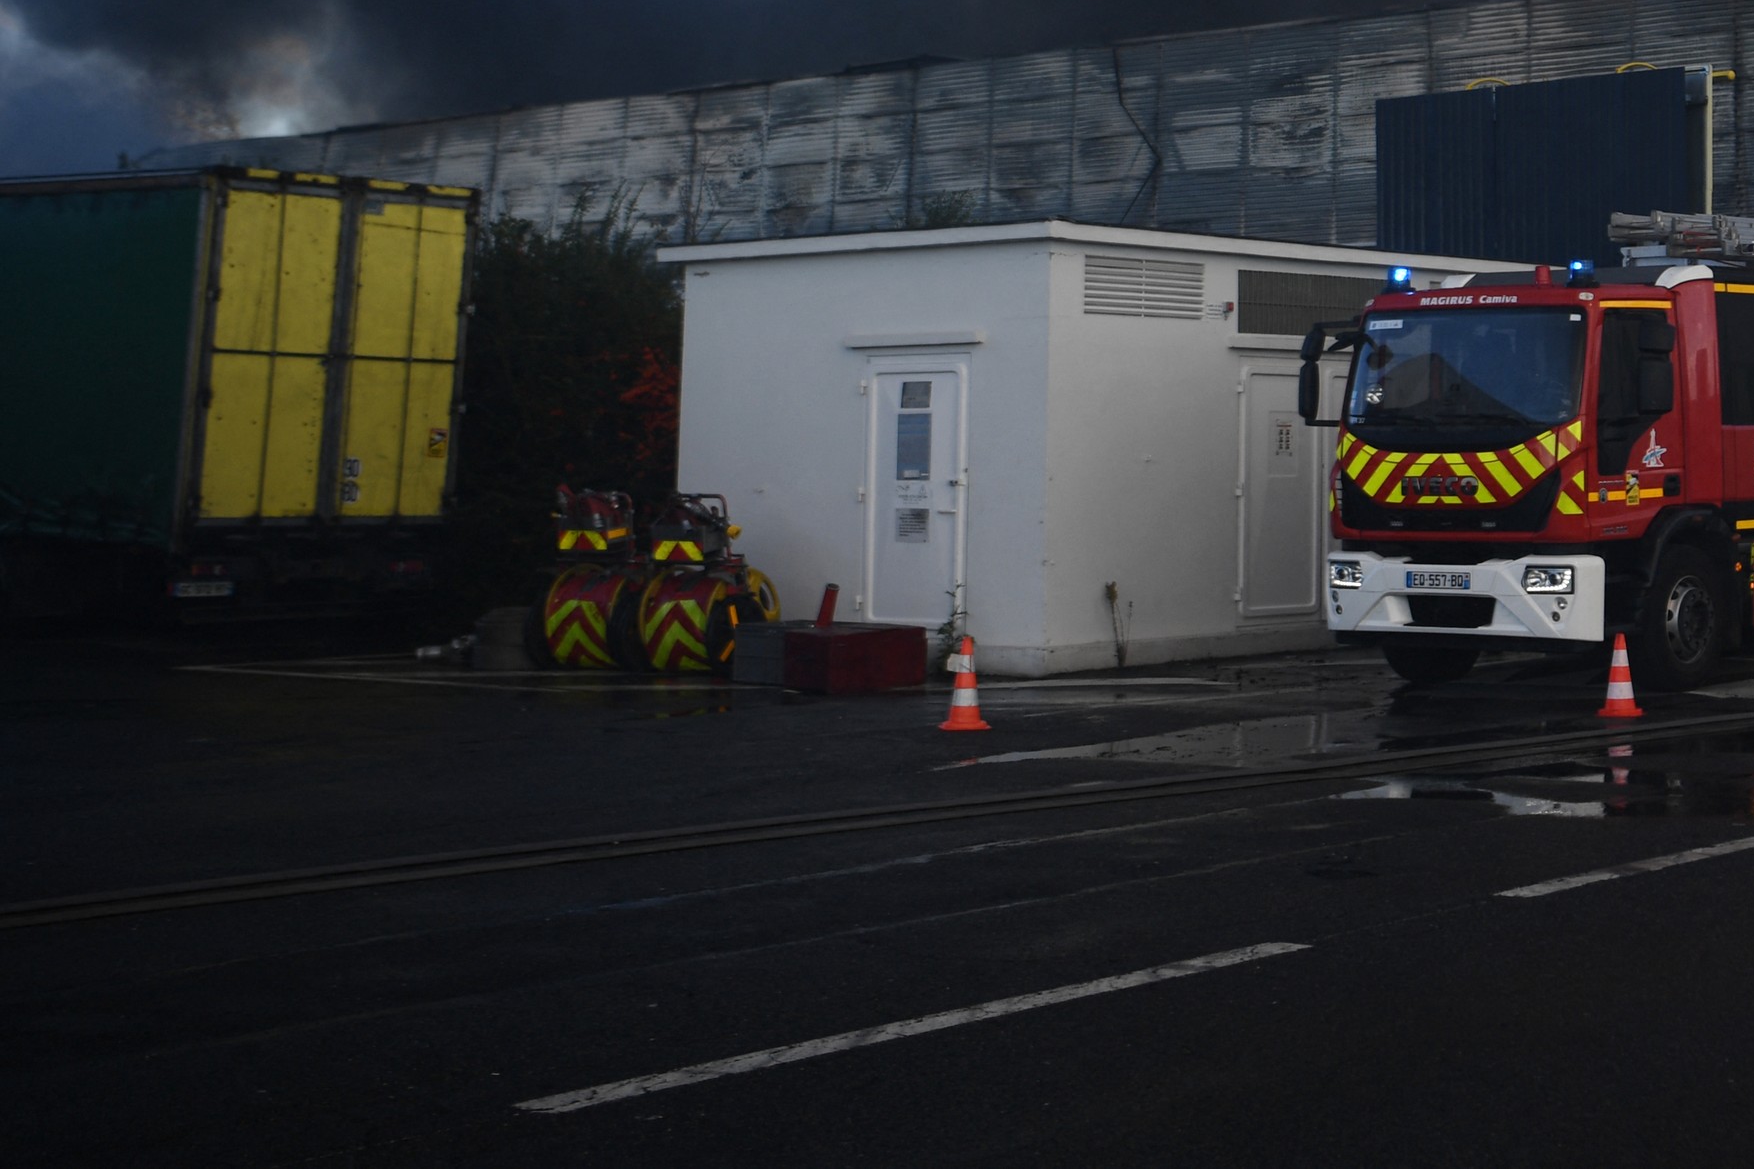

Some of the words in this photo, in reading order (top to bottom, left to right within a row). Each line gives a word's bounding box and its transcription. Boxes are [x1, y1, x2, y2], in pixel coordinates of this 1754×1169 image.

[1420, 295, 1473, 306] MAGIRUS
[1479, 294, 1518, 304] Camiva
[1401, 476, 1479, 496] IVECO
